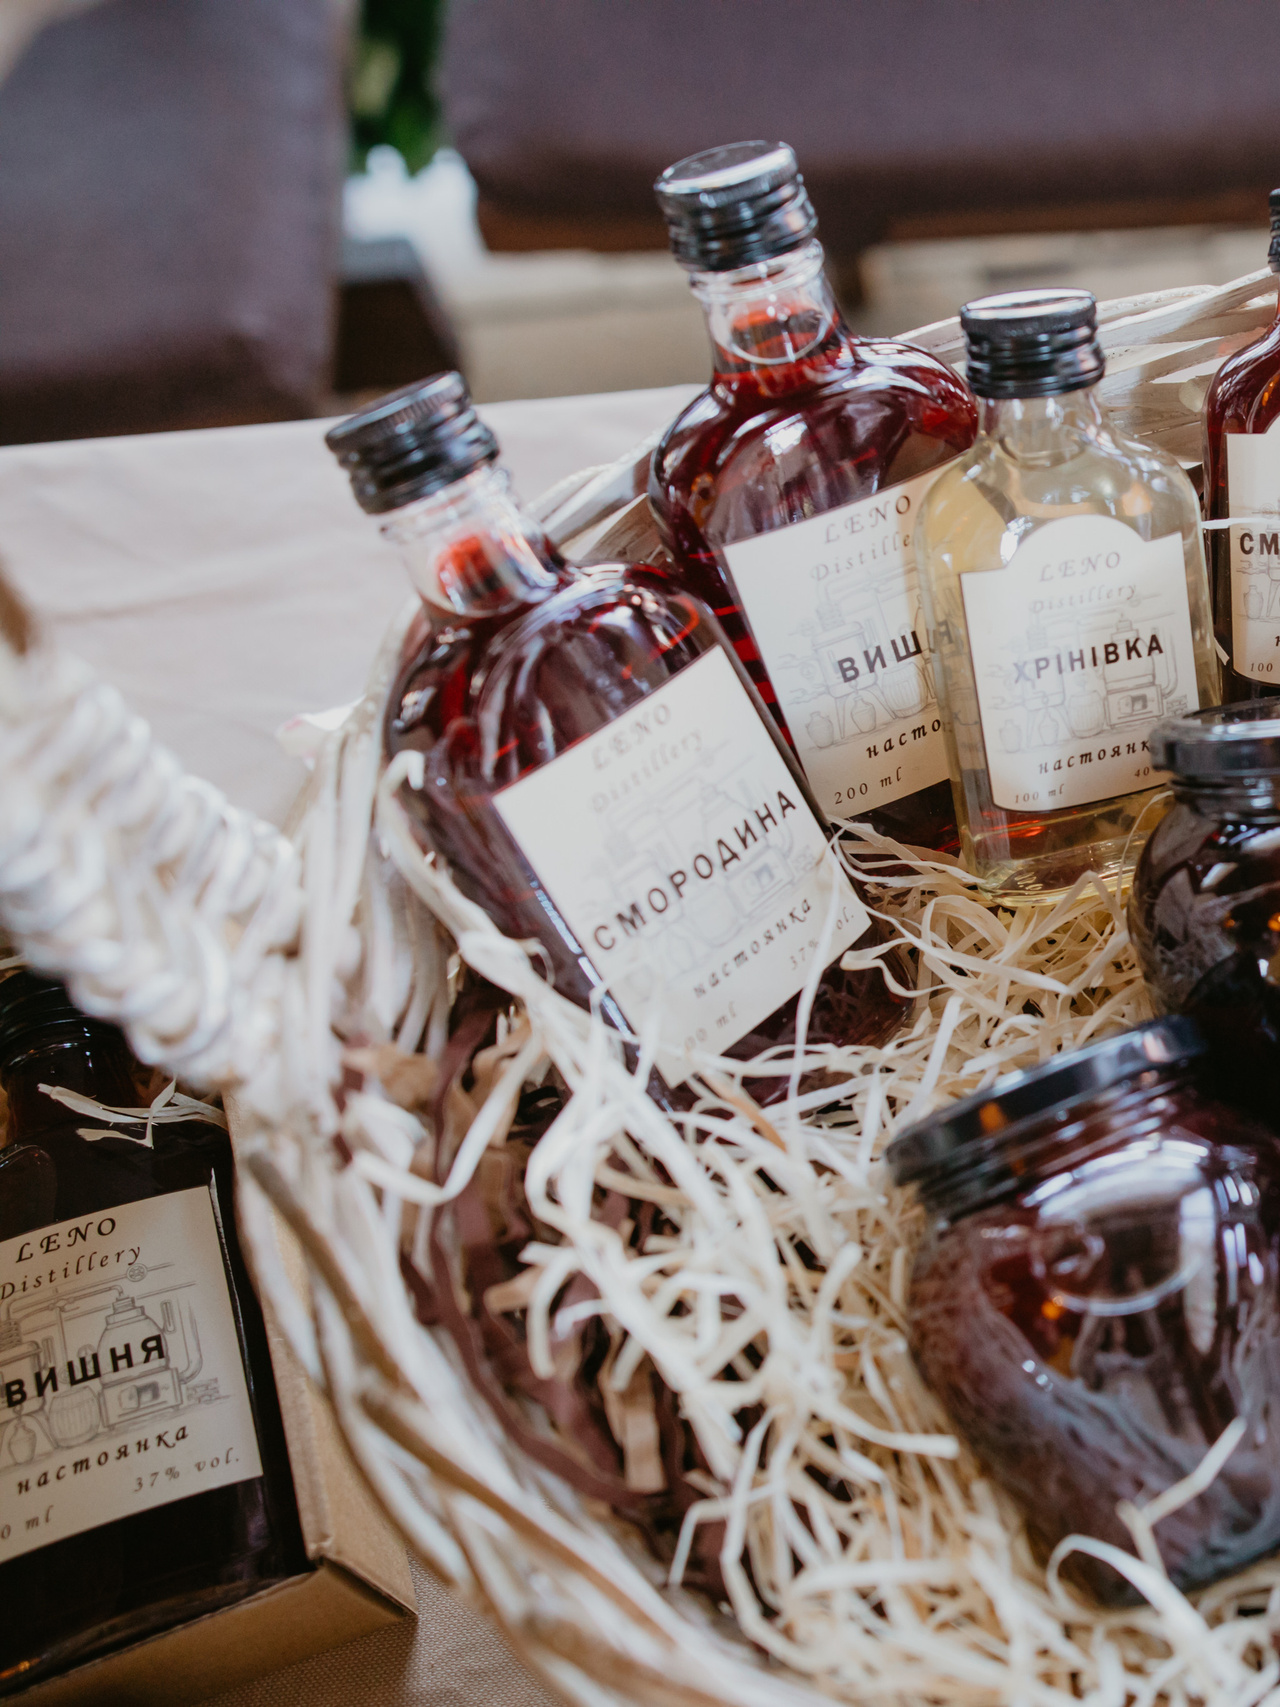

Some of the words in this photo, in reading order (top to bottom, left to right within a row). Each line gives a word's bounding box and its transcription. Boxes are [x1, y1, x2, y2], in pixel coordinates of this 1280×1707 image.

[824, 495, 911, 545] LENO
[810, 532, 911, 582] Distille
[1038, 551, 1121, 583] LENO
[1029, 583, 1137, 614] Distillery
[837, 630, 923, 683] ВИШ
[1013, 634, 1164, 684] ХРІНІВКА
[1250, 662, 1273, 673] 100
[866, 718, 941, 759] насто
[1038, 739, 1150, 774] настоянк
[834, 782, 869, 804] 200
[880, 767, 902, 788] ml
[1015, 791, 1039, 803] 100
[1048, 784, 1065, 797] ml
[1134, 766, 1150, 778] 40
[592, 790, 797, 951] СМОРОДИНА
[693, 899, 811, 998] настоянка
[15, 1217, 117, 1264] LENO
[0, 1245, 142, 1300] Distillery
[4, 1333, 166, 1408] ВИШНЯ
[16, 1424, 189, 1496] настоянка
[134, 1465, 181, 1492] 37%
[195, 1446, 240, 1472] vol.
[25, 1504, 54, 1531] ml
